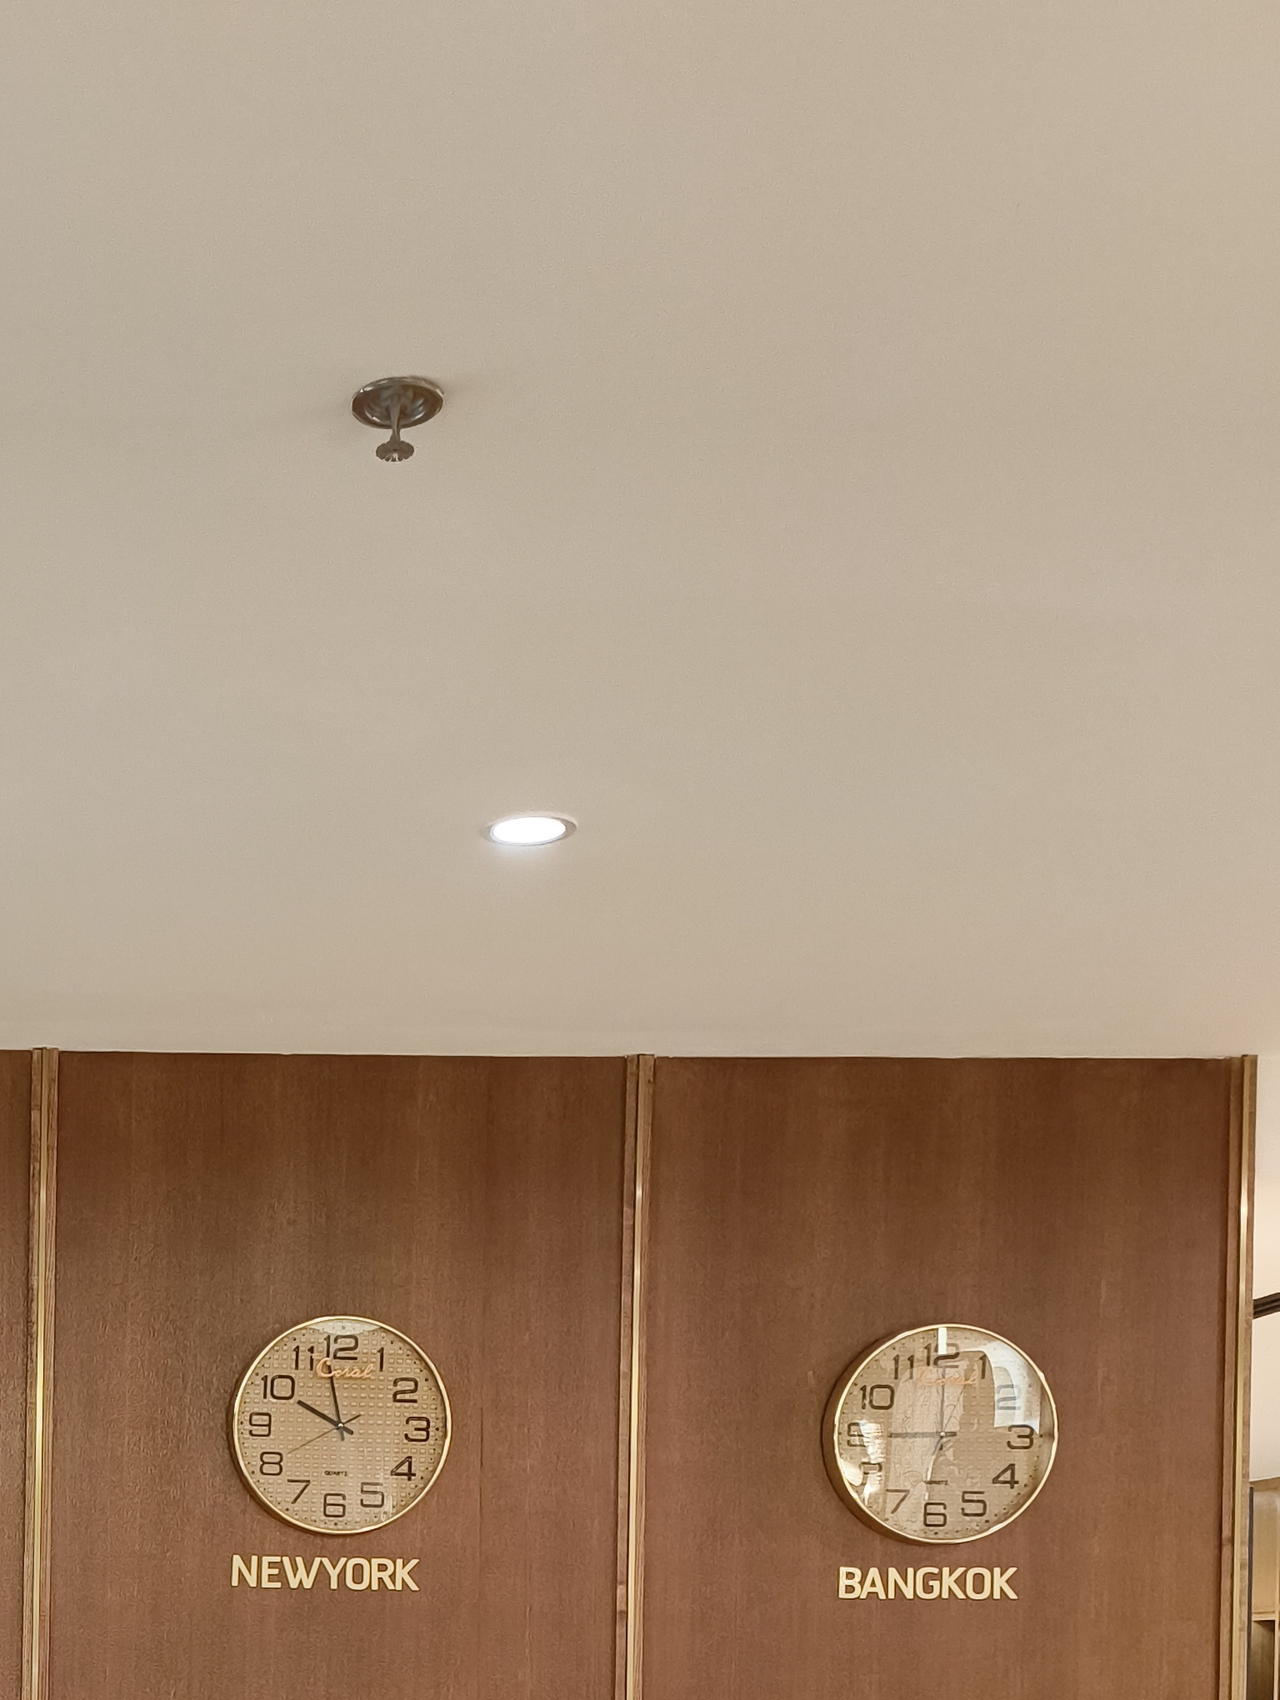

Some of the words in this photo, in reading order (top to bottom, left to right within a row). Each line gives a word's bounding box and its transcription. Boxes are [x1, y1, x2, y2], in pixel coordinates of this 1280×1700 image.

[293, 1346, 314, 1371] 11
[324, 1335, 358, 1360] 12
[377, 1347, 384, 1371] 1
[924, 1343, 960, 1368] 12
[316, 1358, 373, 1379] Coral
[893, 1354, 914, 1379] 11
[978, 1355, 986, 1379] 1
[261, 1375, 295, 1400] 10
[393, 1377, 418, 1403] 2
[860, 1385, 894, 1410] 10
[996, 1384, 1021, 1410] 2
[249, 1412, 271, 1437] 9
[404, 1417, 430, 1442] 3
[1007, 1425, 1034, 1450] 3
[260, 1452, 283, 1476] 8
[391, 1456, 416, 1481] 4
[992, 1464, 1019, 1489] 4
[287, 1479, 310, 1504] 7
[360, 1482, 384, 1508] 5
[886, 1489, 910, 1514] 7
[961, 1491, 986, 1517] 5
[323, 1493, 346, 1517] 6
[924, 1503, 947, 1527] 6
[231, 1555, 420, 1591] NEWYORK
[838, 1567, 1018, 1599] BANGKOK
